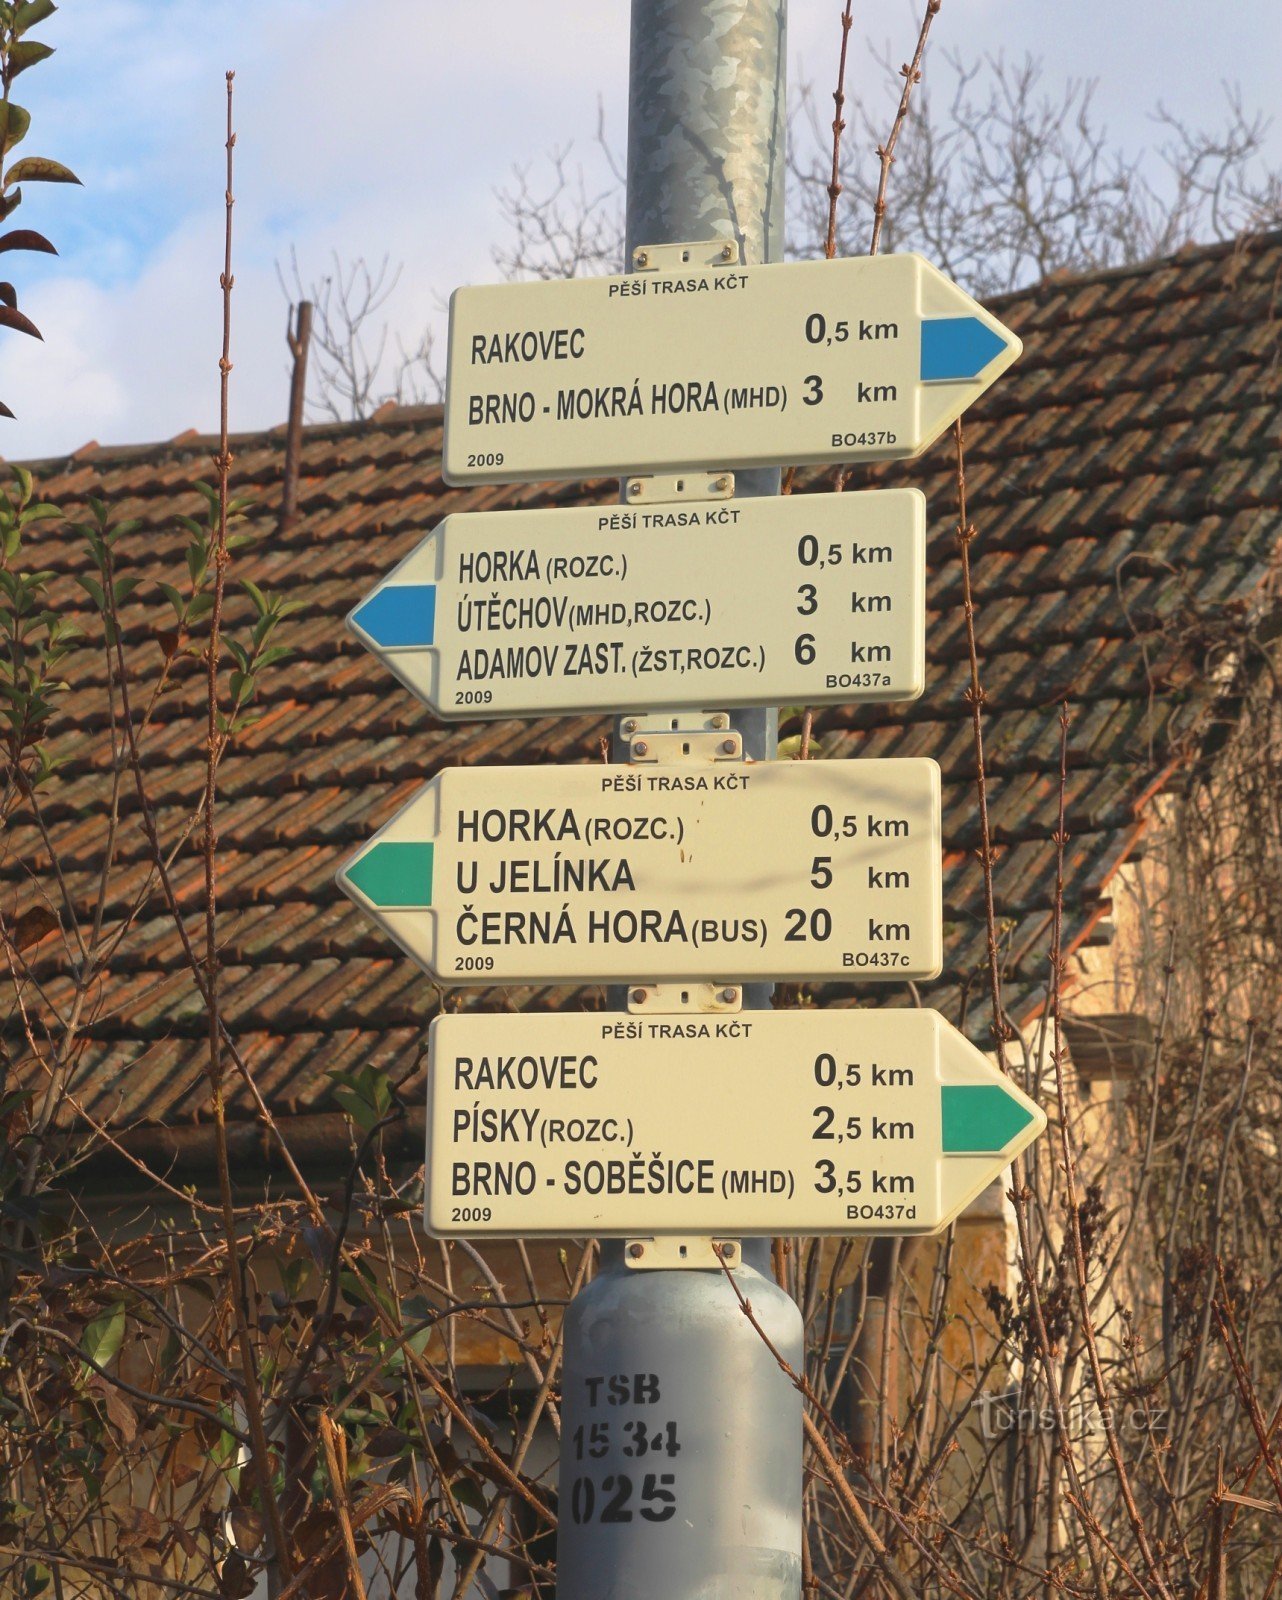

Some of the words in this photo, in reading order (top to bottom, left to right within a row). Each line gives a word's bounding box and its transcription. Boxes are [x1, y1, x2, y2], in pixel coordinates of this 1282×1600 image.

[609, 280, 646, 297] PĚŠÍ
[652, 279, 709, 294] TRASA
[715, 274, 748, 290] KČT
[472, 328, 584, 364] RAKOVEC
[806, 314, 848, 346] 0,5
[859, 320, 897, 340] km
[469, 392, 535, 425] BRNO
[557, 378, 643, 420] MOKRÁ
[803, 375, 823, 405] 3
[858, 383, 896, 402] km
[468, 453, 503, 467] 2009
[832, 431, 896, 446] BO437b
[599, 513, 636, 530] PĚŠÍ
[642, 513, 700, 528] TRASA
[706, 508, 740, 524] KČT
[798, 535, 842, 569] 0,5
[853, 543, 891, 563] km
[797, 584, 817, 615] 3
[852, 592, 891, 612] km
[457, 646, 559, 680] ADAMOV
[795, 634, 816, 665] 6
[852, 642, 890, 662] km
[455, 691, 492, 704] 2009
[827, 673, 890, 688] BO437a
[602, 775, 641, 791] PĚŠÍ
[647, 777, 708, 790] TRASA
[714, 773, 750, 789] KČT
[812, 805, 857, 841] 0,5
[868, 815, 908, 836] km
[457, 861, 477, 893] U
[490, 852, 635, 893] JELÍNKA
[811, 857, 832, 889] 5
[869, 867, 909, 888] km
[457, 903, 576, 945] ČERNÁ
[785, 908, 831, 941] 20
[869, 919, 909, 940] km
[455, 957, 493, 970] 2009
[843, 953, 909, 966] BO437c
[602, 1022, 642, 1039] PĚŠÍ
[648, 1025, 710, 1038] TRASA
[716, 1022, 752, 1037] KČT
[455, 1056, 597, 1090] RAKOVEC
[815, 1054, 861, 1090] 0,5
[872, 1064, 913, 1085] km
[812, 1106, 861, 1143] 2,5
[873, 1117, 913, 1139] km
[452, 1161, 536, 1195] BRNO
[815, 1159, 861, 1197] 3,5
[873, 1170, 914, 1193] km
[452, 1208, 491, 1221] 2009
[847, 1205, 915, 1219] BO437d
[585, 1373, 661, 1407] TSB
[571, 1474, 677, 1524] 025
